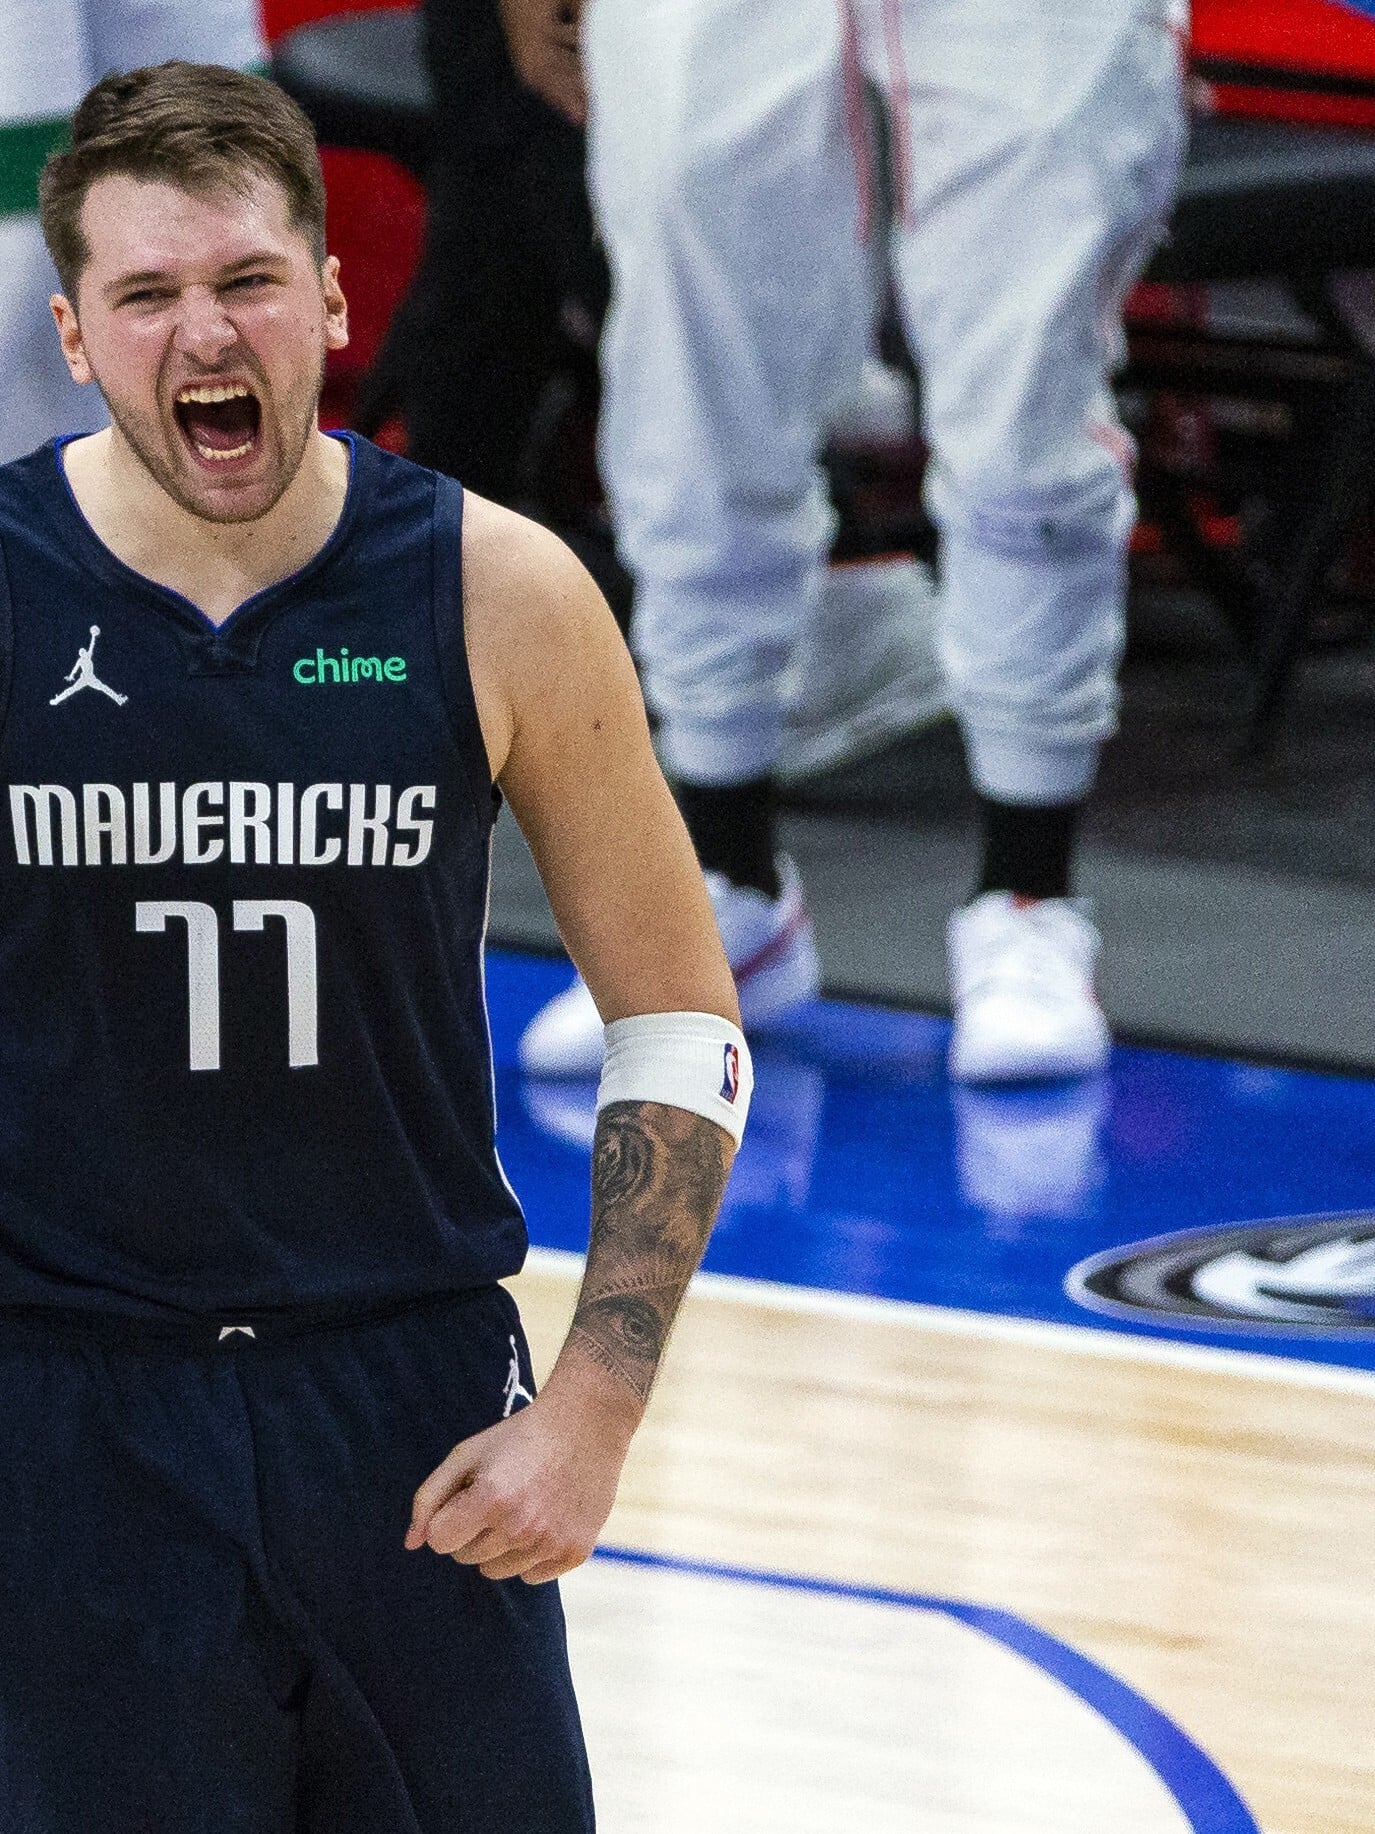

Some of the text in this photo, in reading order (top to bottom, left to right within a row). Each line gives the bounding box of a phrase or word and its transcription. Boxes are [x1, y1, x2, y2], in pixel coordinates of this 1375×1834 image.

[293, 647, 408, 684] chime
[8, 781, 437, 867] MAVERICKS
[135, 899, 319, 1071] 77
